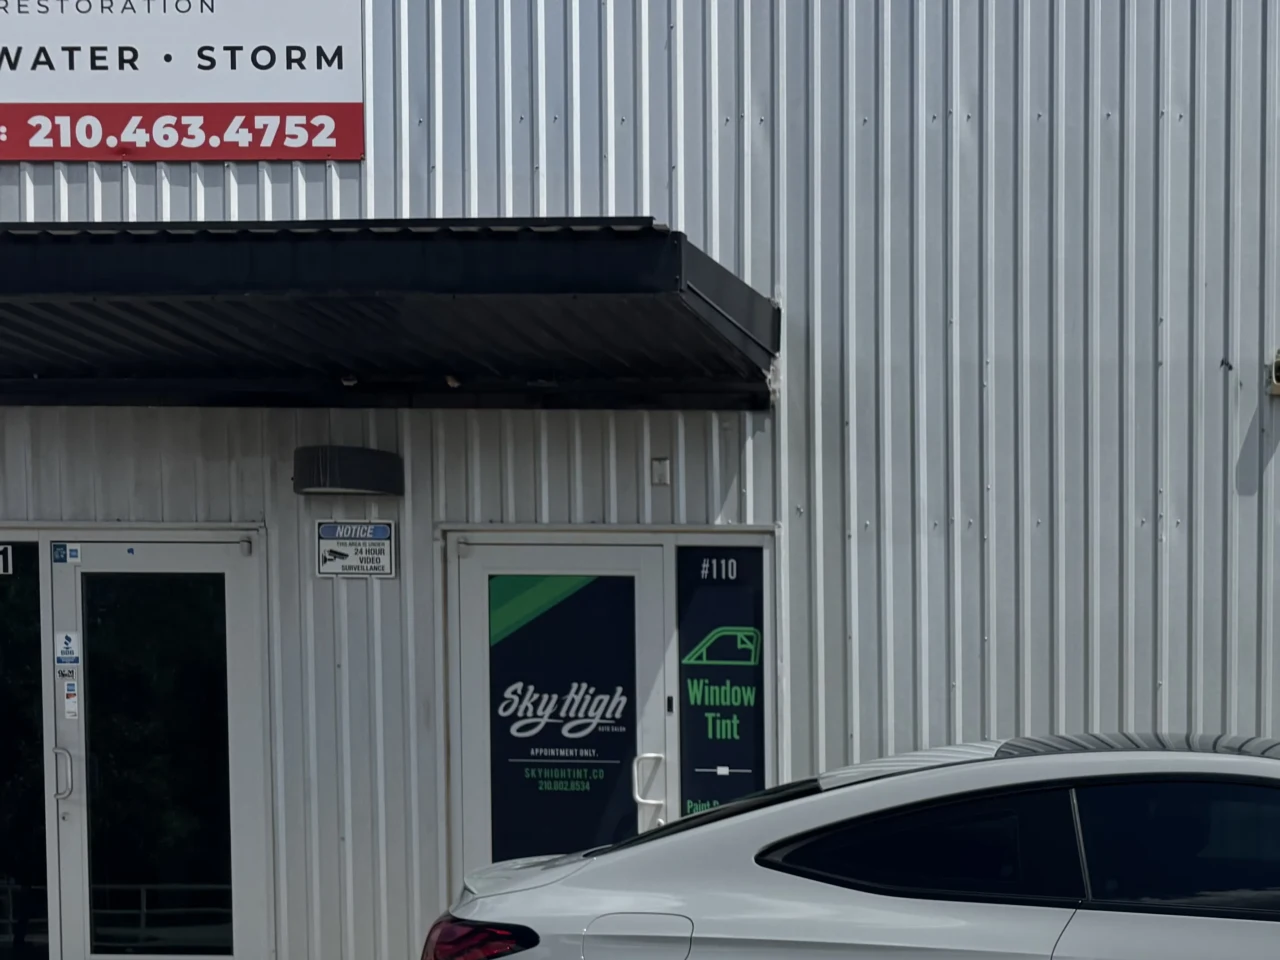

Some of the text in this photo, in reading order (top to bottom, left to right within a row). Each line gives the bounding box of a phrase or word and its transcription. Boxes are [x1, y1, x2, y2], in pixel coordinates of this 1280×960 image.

[0, 0, 216, 14] RESTORATION
[0, 45, 344, 71] WATER STORM
[27, 115, 337, 148] 210.463.4752
[335, 525, 375, 538] NOTICE
[354, 548, 385, 556] 24 HOUR
[359, 556, 381, 564] VIDEO
[701, 558, 737, 580] #110
[687, 678, 756, 707] Window
[498, 681, 628, 738] Sky High
[704, 712, 740, 739] Tint
[530, 748, 578, 757] APPOINTMENT
[524, 767, 605, 780] SKYHIGHTINT.CO
[687, 799, 710, 814] Paint
